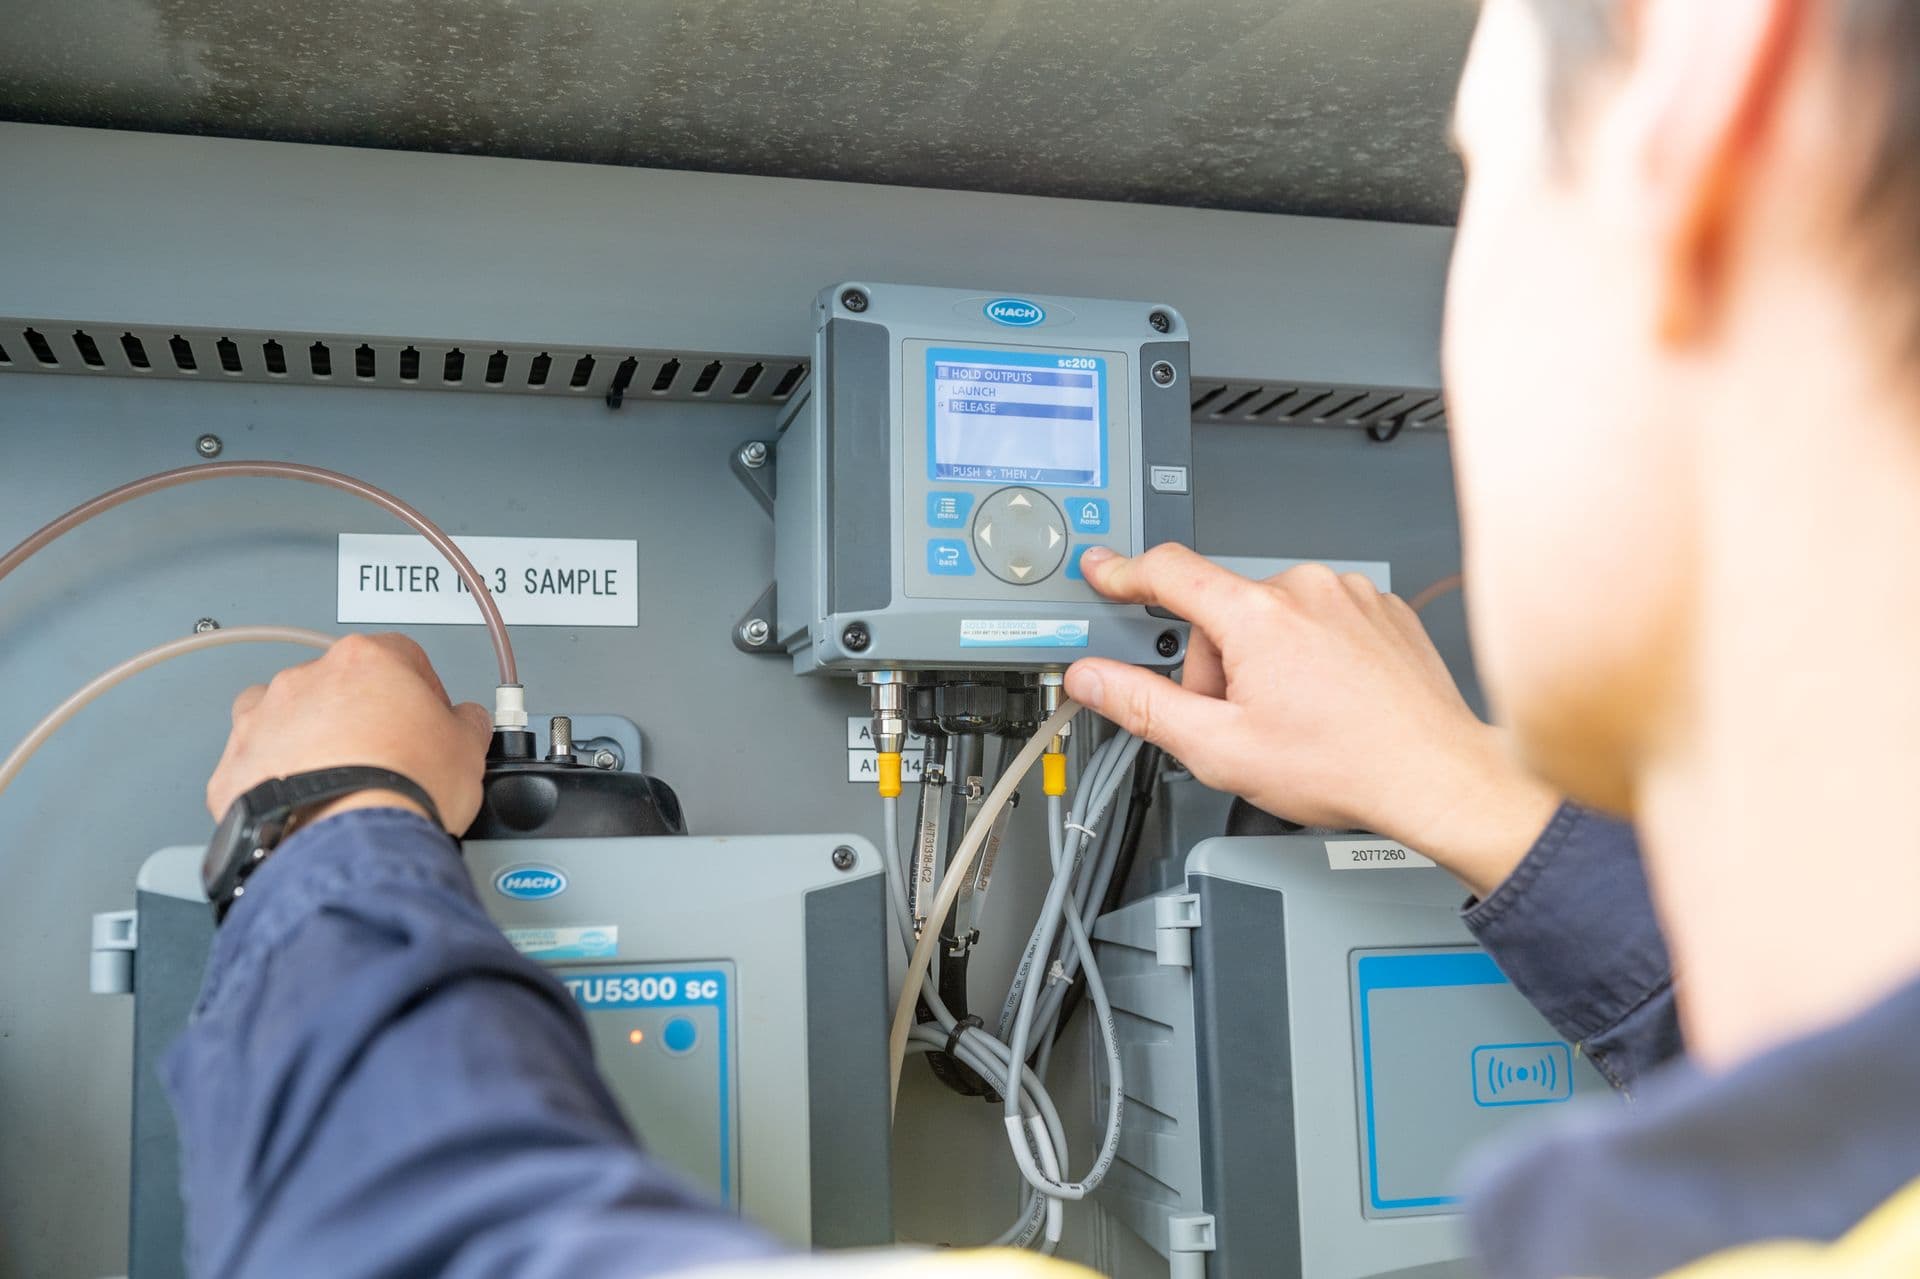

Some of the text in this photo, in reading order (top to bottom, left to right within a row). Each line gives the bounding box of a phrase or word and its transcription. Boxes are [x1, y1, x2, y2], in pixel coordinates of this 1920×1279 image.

[994, 307, 1036, 318] HACH
[1057, 357, 1097, 370] sc200
[951, 368, 1033, 383] HOLD OUTPUTS
[951, 385, 997, 398] LAUNCH
[951, 401, 997, 414] RELEASE
[952, 466, 1028, 480] PUSH THEN
[937, 512, 960, 520] menu
[1079, 518, 1101, 526] home
[938, 556, 958, 566] back
[359, 564, 440, 593] FILTER
[524, 568, 618, 596] SAMPLE
[1351, 849, 1406, 862] 2077260
[506, 877, 559, 889] HACH
[563, 976, 718, 1003] TU5300 sc
